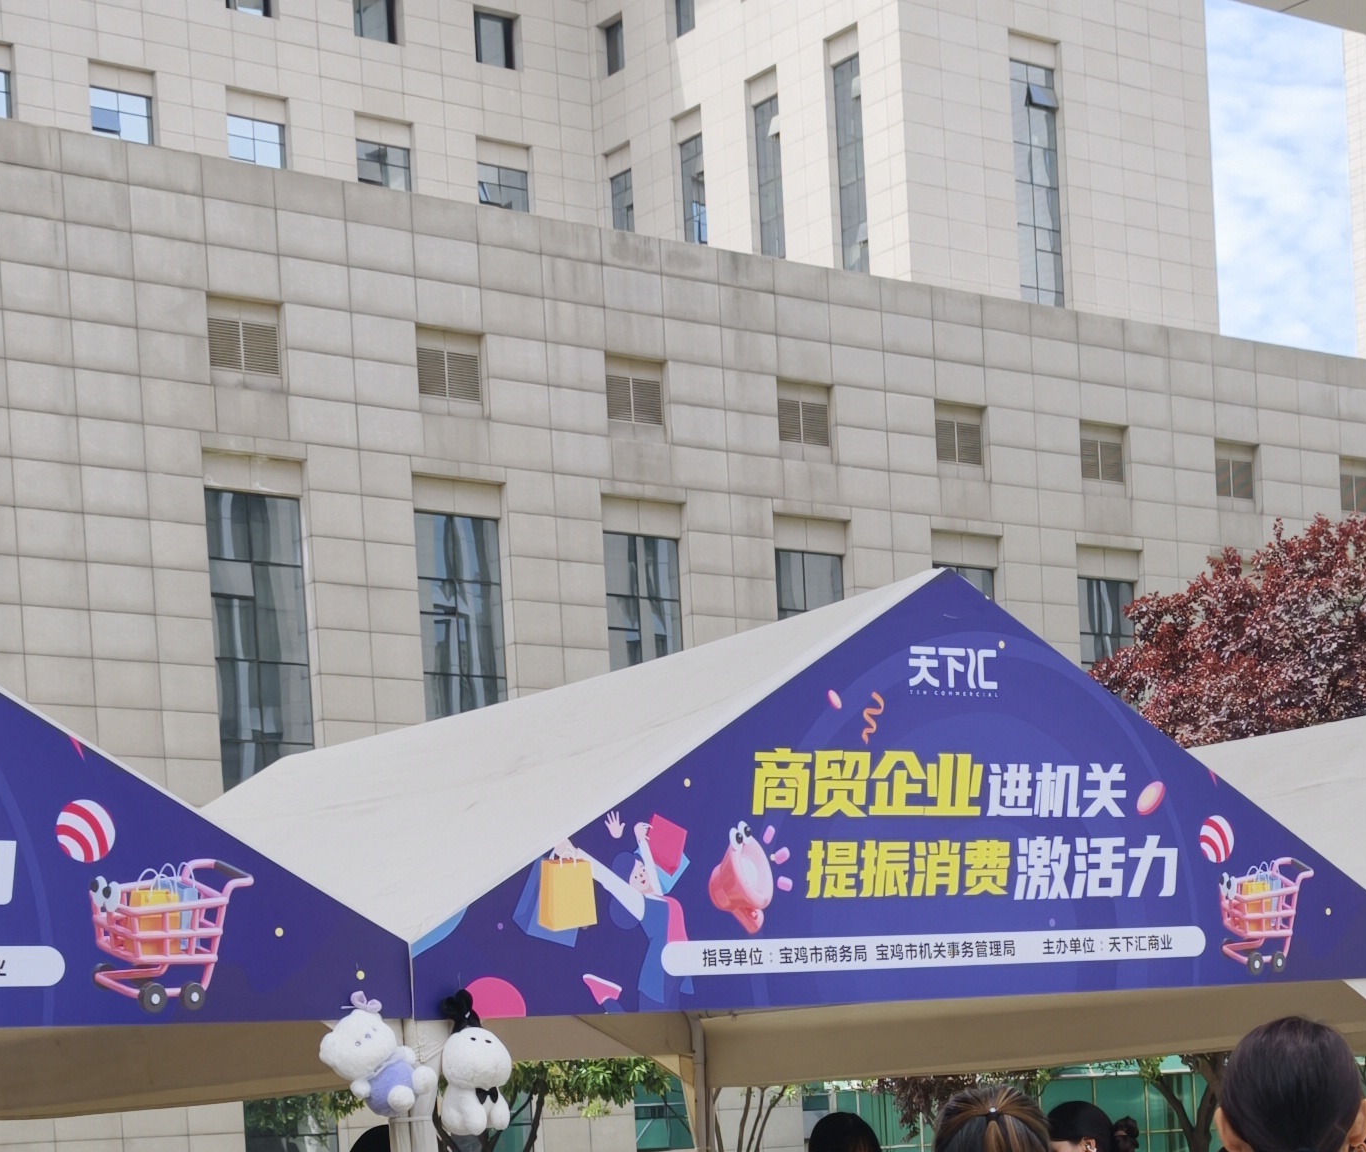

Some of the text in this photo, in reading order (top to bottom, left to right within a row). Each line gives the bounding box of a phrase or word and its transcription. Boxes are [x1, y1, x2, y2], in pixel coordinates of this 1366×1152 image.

[908, 645, 998, 690] 天下汇
[752, 748, 1127, 818] 商贸企业进机关
[806, 835, 1179, 901] 提振消费激活力
[876, 940, 1016, 962] 宝鸡市机关事务管理局
